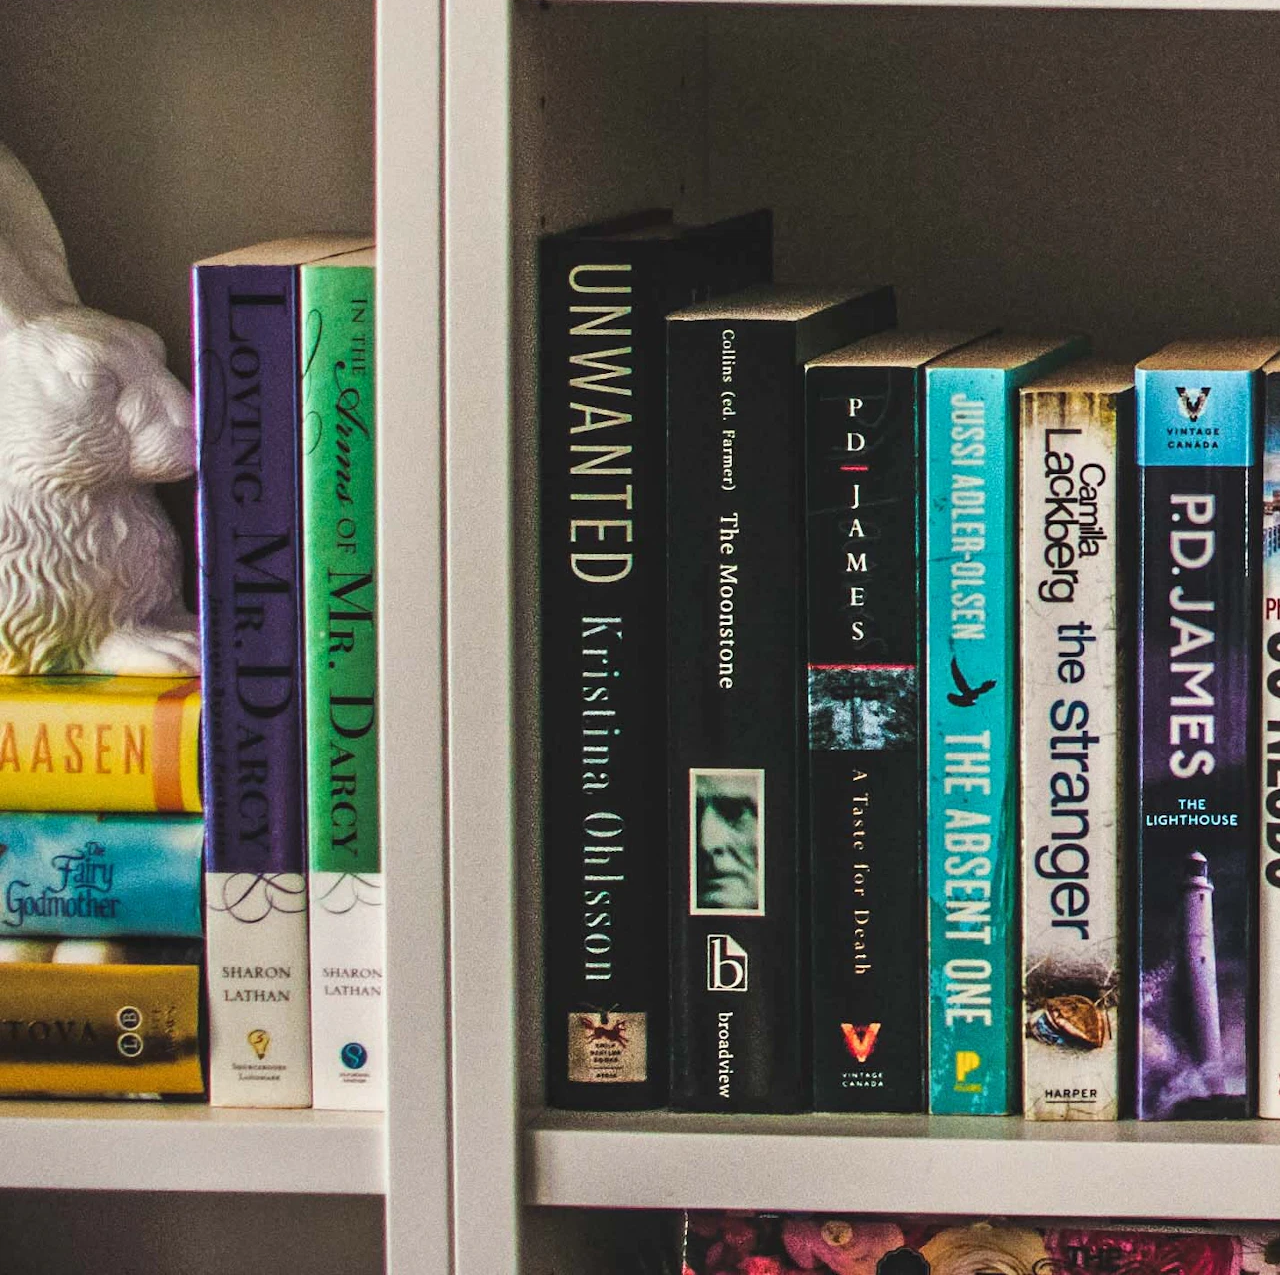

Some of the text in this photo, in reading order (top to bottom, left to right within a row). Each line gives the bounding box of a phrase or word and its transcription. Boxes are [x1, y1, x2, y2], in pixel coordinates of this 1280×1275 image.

[719, 328, 738, 493] Collins (ed. Farmer)
[1167, 428, 1221, 437] VINTAGE
[1167, 441, 1220, 450] CANADA
[949, 393, 985, 640] JUSSI ADLER-OLSEN
[1037, 428, 1083, 603] Lackberg
[1077, 463, 1108, 558] Camilla
[717, 513, 740, 690] The Moonstone
[1168, 585, 1215, 779] JAMES
[1034, 621, 1101, 940] the stranger
[1146, 814, 1239, 826] LIGHTHOUSE
[1177, 800, 1206, 810] THE
[851, 769, 871, 975] A Taste for Death
[943, 730, 993, 1027] THE ABSENT ONE
[221, 966, 292, 979] SHARON
[224, 990, 291, 1002] LATHAN
[716, 1012, 736, 1099] broadview
[1044, 1090, 1097, 1100] HARPER
